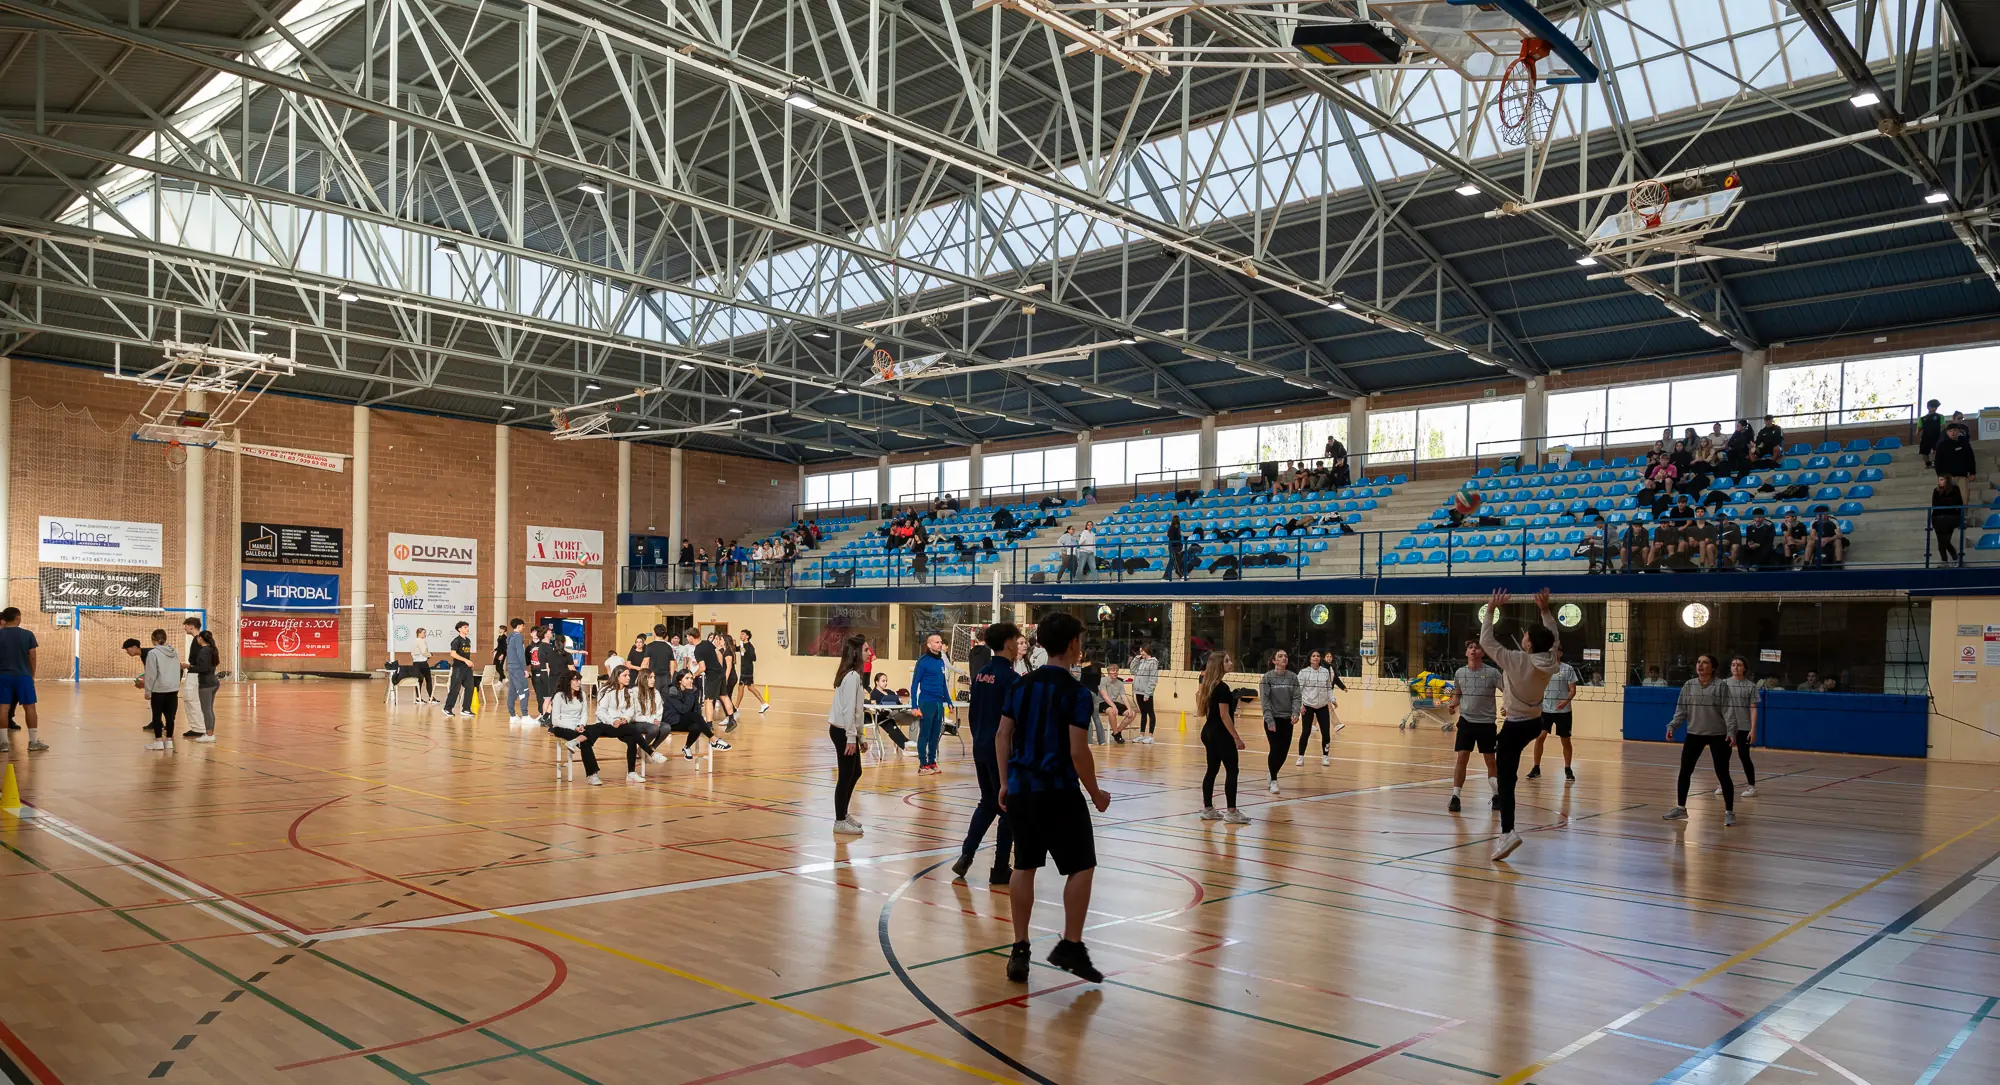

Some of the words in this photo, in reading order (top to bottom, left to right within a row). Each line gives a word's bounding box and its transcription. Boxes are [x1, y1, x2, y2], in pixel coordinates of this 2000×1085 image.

[50, 521, 112, 543] Palmer
[411, 545, 473, 560] DURAN
[554, 540, 582, 551] PORT
[52, 581, 100, 596] Juan
[104, 583, 149, 598] Oliver
